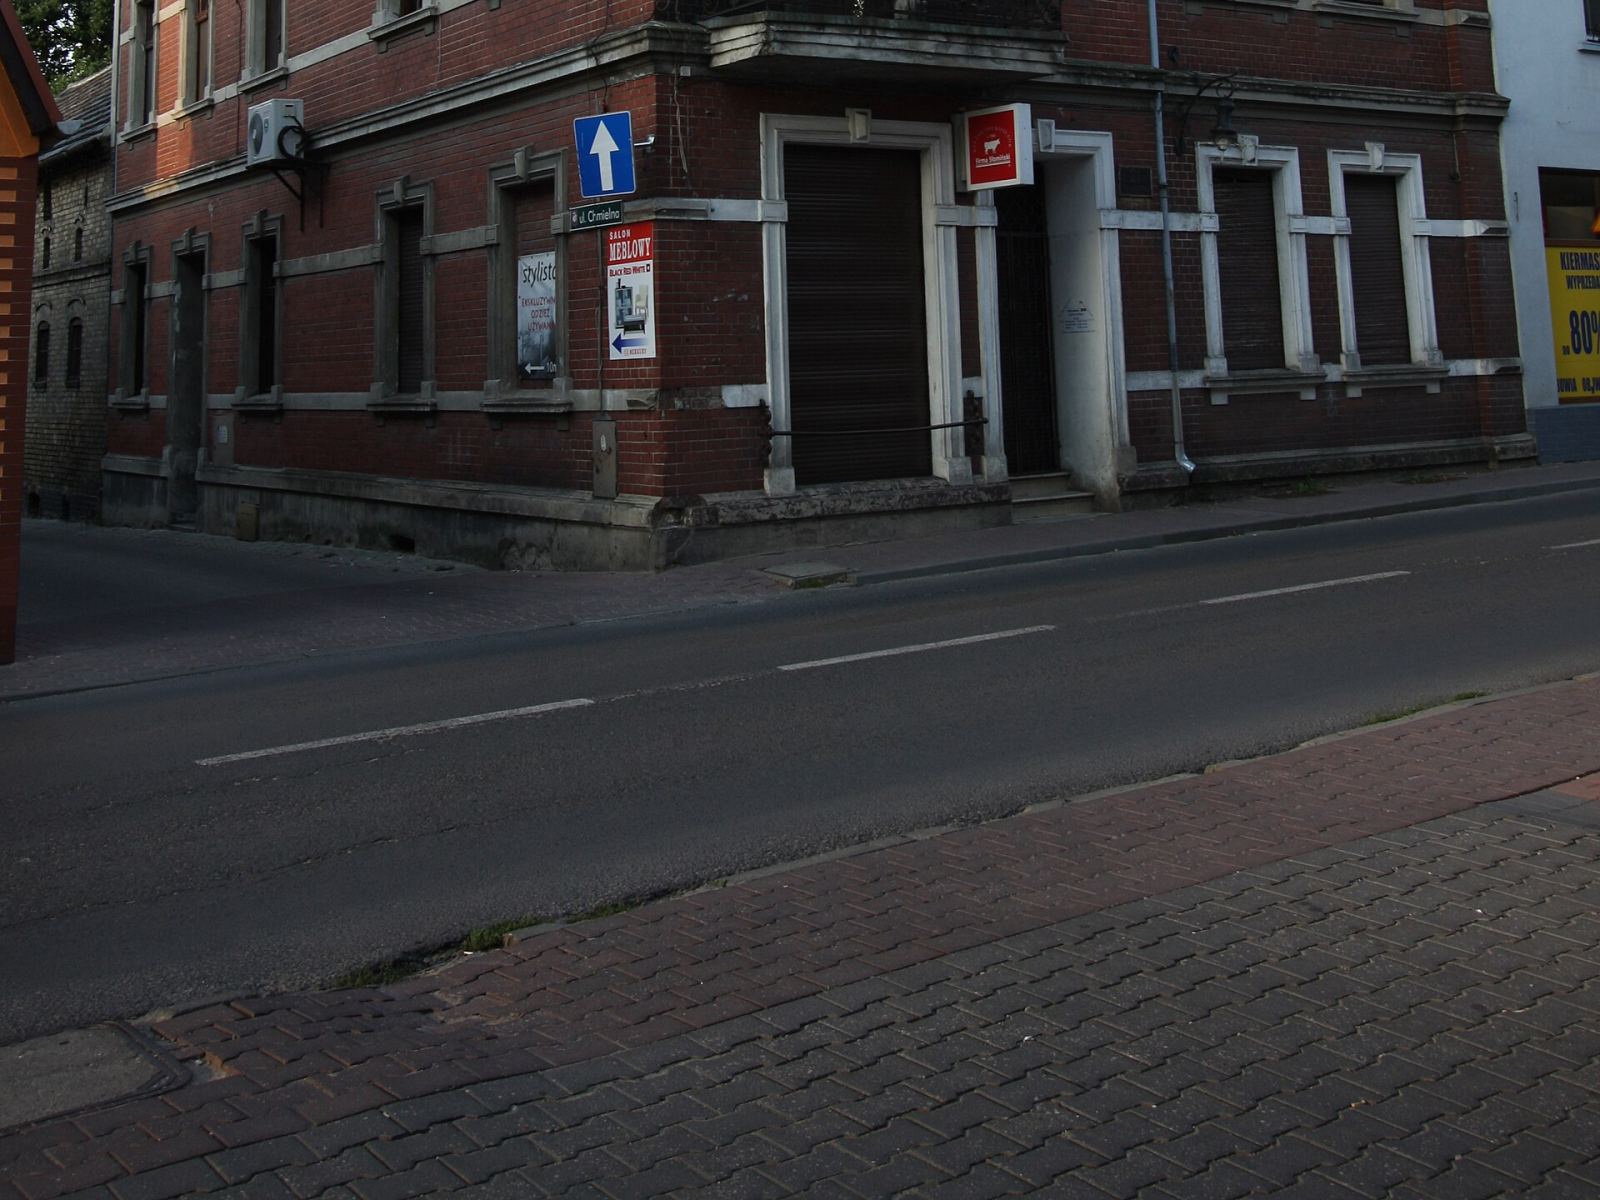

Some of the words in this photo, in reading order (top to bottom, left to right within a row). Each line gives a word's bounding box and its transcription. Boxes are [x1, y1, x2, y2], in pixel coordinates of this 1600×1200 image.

[587, 208, 620, 223] Chmielna
[609, 229, 631, 240] SALON
[609, 238, 651, 261] MEBLOWY
[1560, 252, 1600, 270] KIERMAS
